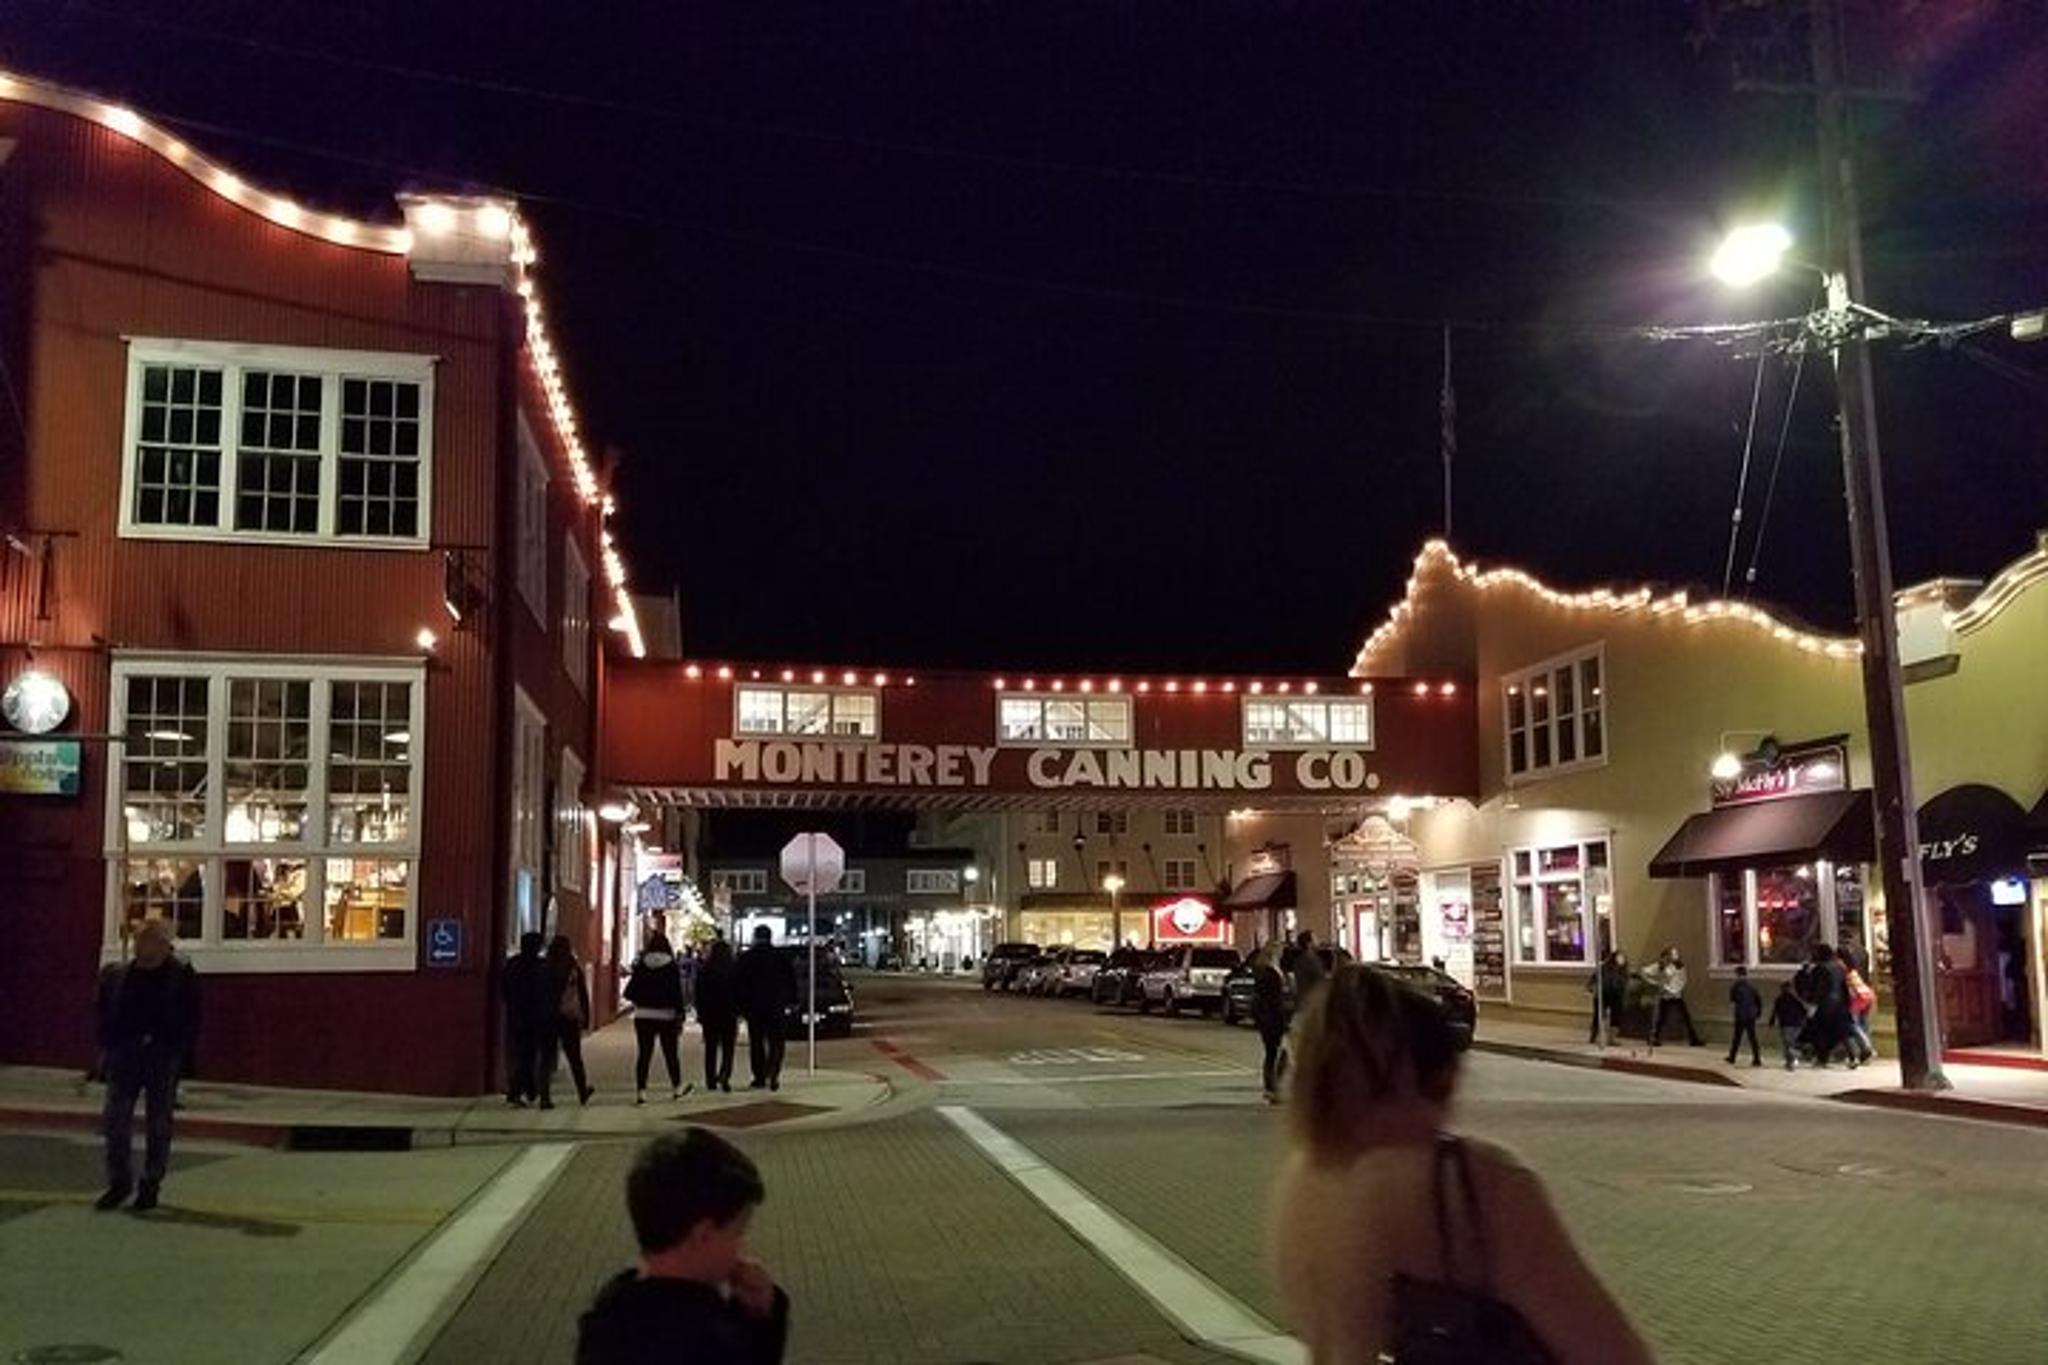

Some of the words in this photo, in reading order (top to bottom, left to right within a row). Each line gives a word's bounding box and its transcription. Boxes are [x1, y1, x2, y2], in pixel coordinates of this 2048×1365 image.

[714, 738, 998, 786] MONTEREY
[1026, 750, 1272, 788] CANNING
[1296, 750, 1380, 789] CO.
